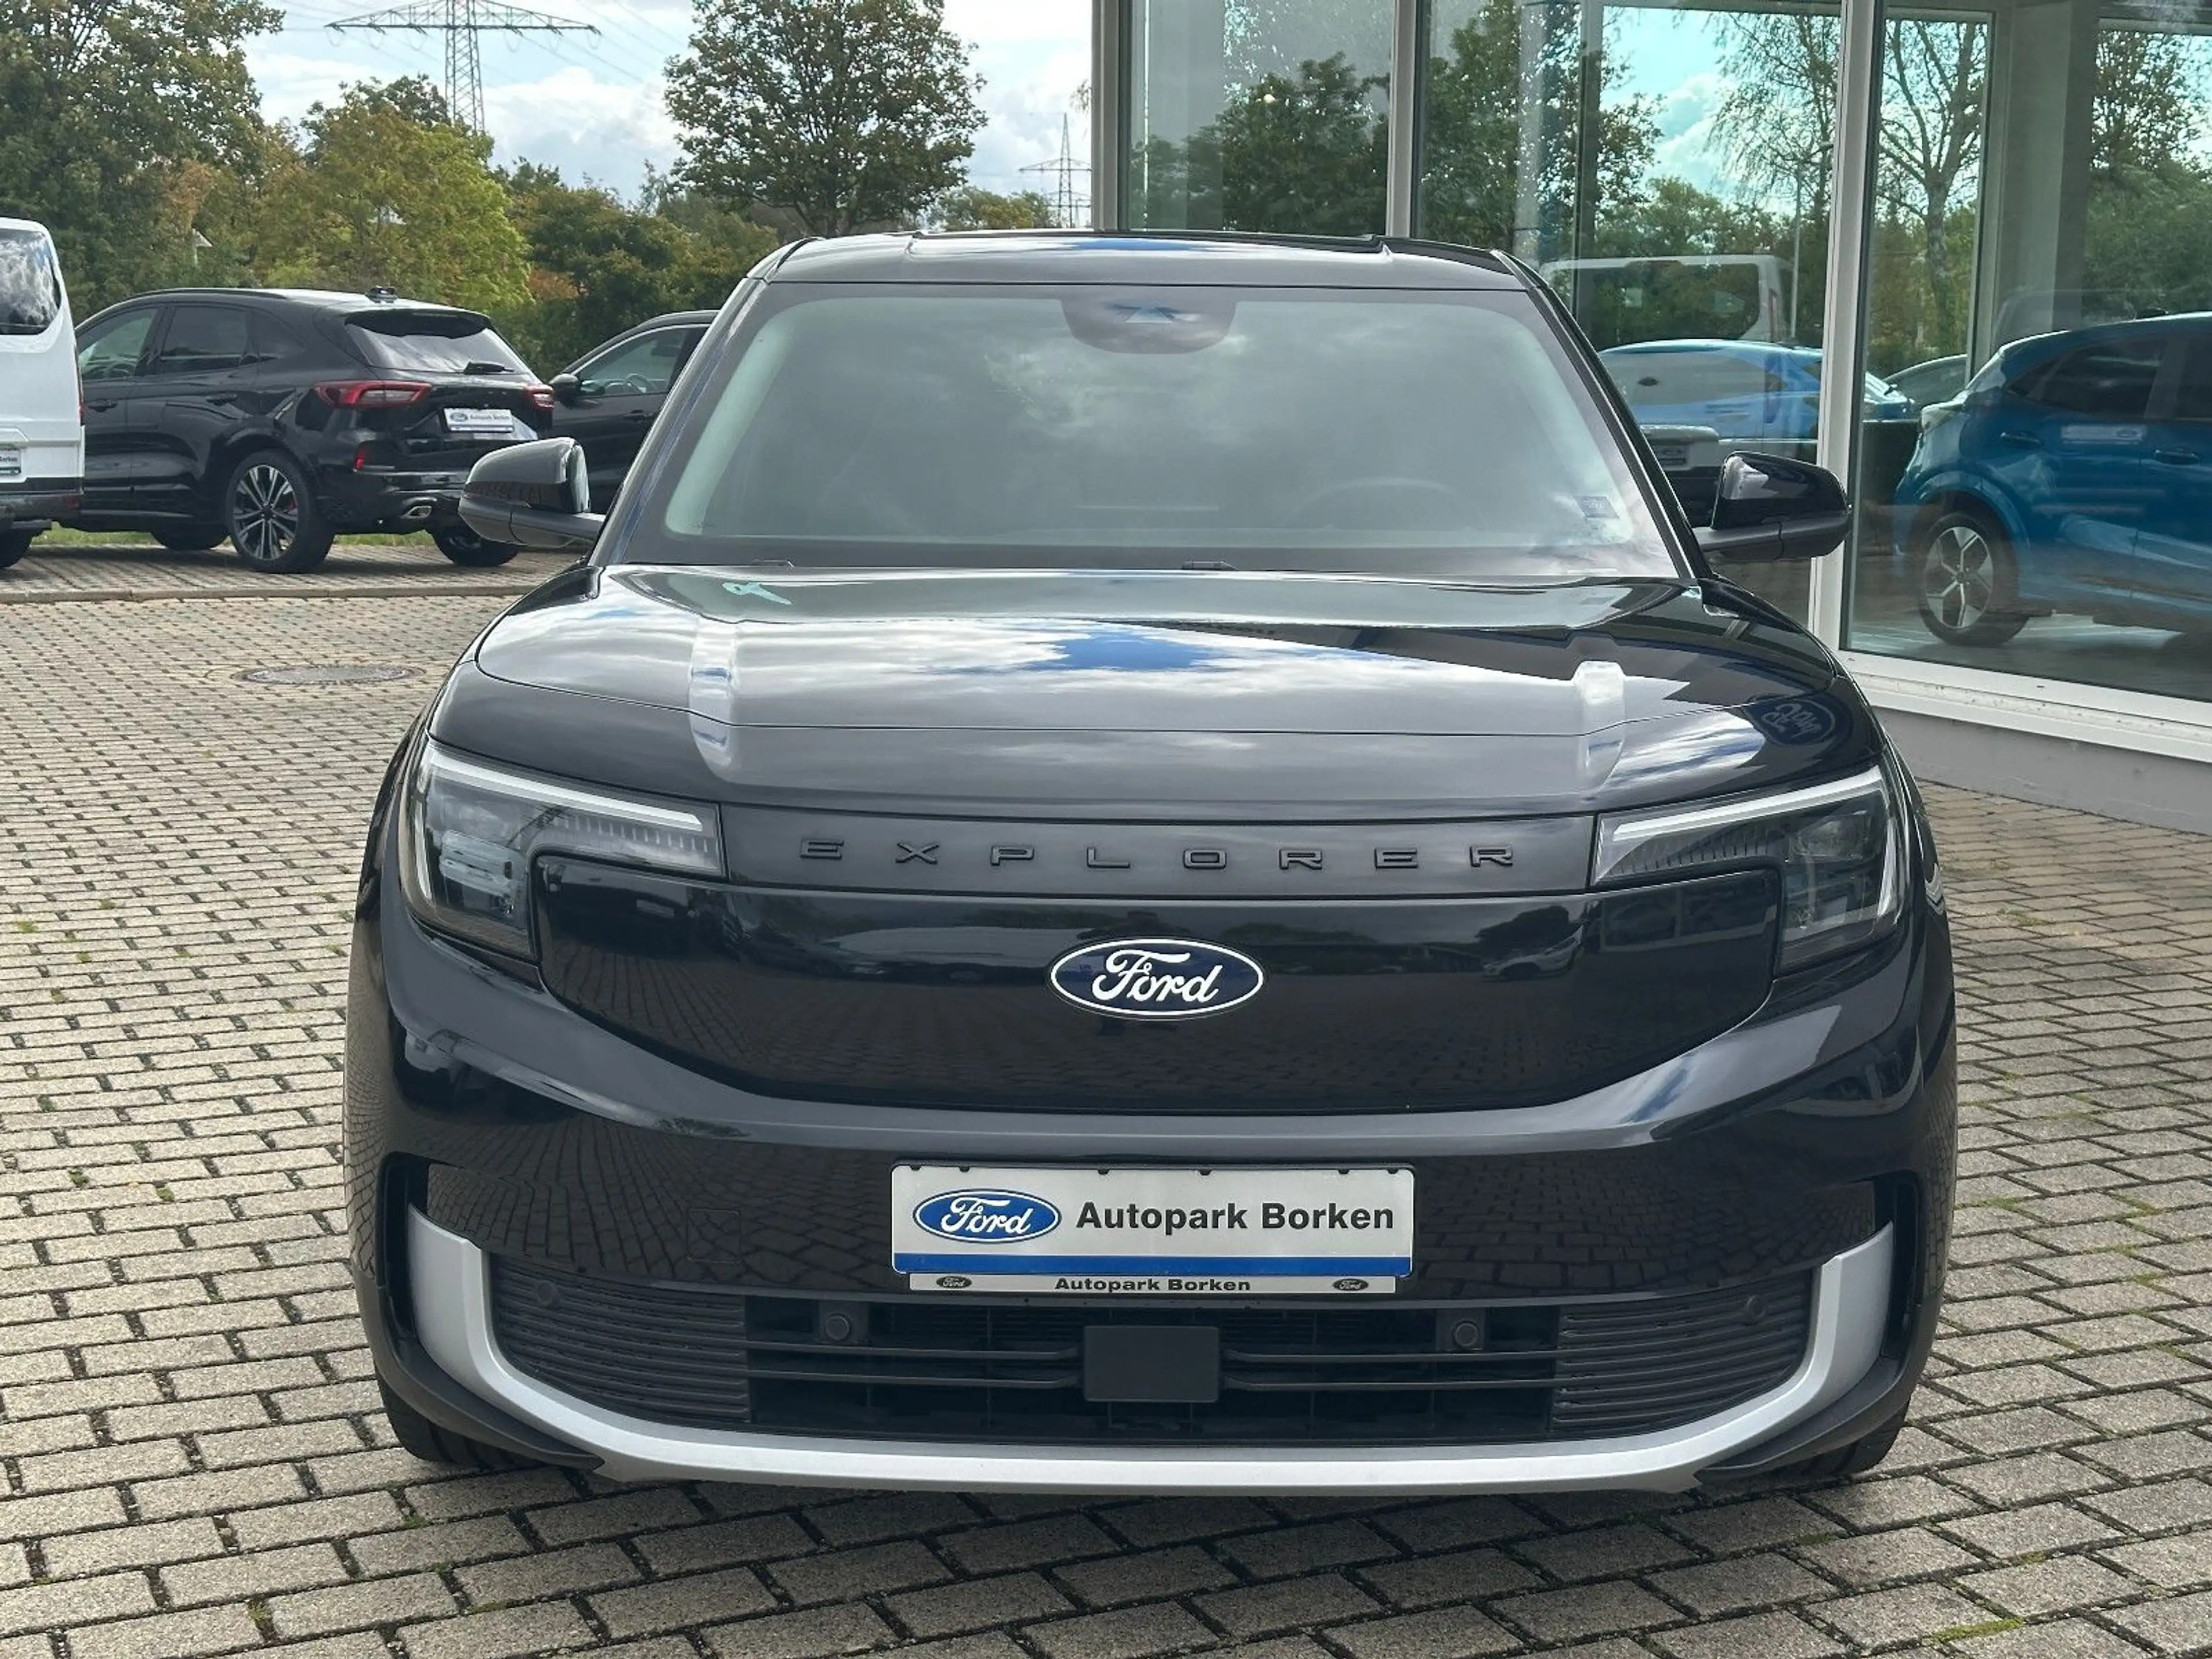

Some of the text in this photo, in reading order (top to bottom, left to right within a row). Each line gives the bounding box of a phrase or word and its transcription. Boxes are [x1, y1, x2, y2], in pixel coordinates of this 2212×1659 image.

[800, 839, 1514, 870] EXPLORER
[1092, 949, 1224, 1003] Ford
[940, 1196, 1394, 1236] Ford Autopark Borken
[942, 1277, 1362, 1293] Ford Autopark Borken Ford
